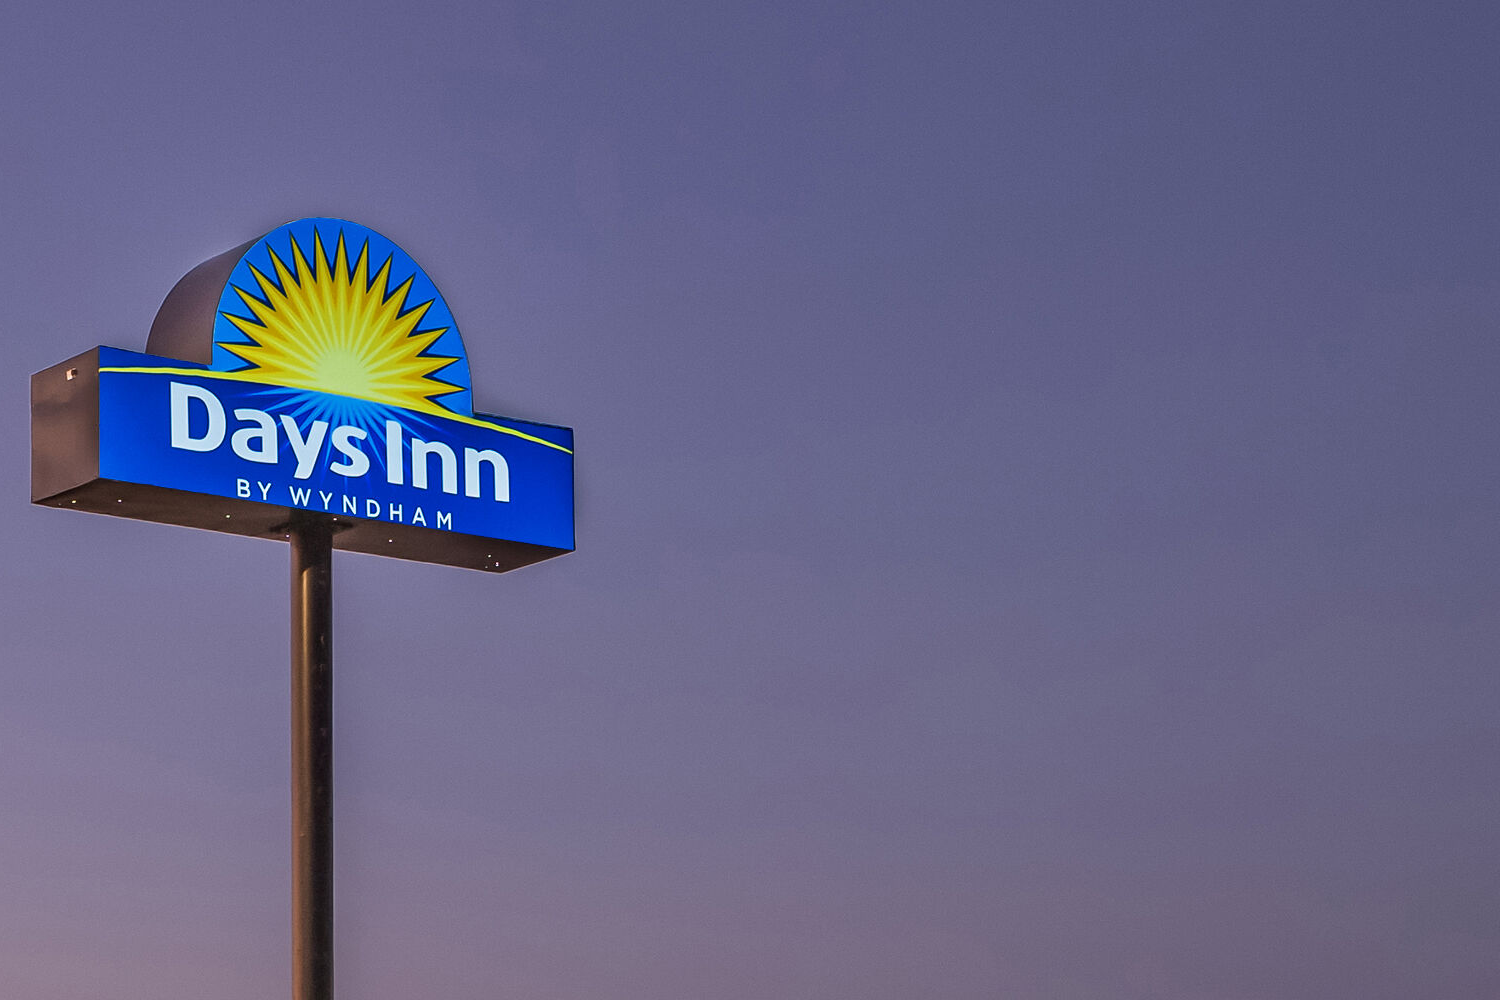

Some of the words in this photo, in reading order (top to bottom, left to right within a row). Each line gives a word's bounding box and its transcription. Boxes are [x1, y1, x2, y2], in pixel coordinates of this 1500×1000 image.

[170, 381, 370, 480] Days
[386, 420, 510, 502] Inn
[236, 478, 272, 501] BY
[289, 486, 452, 530] WYNDHAM
